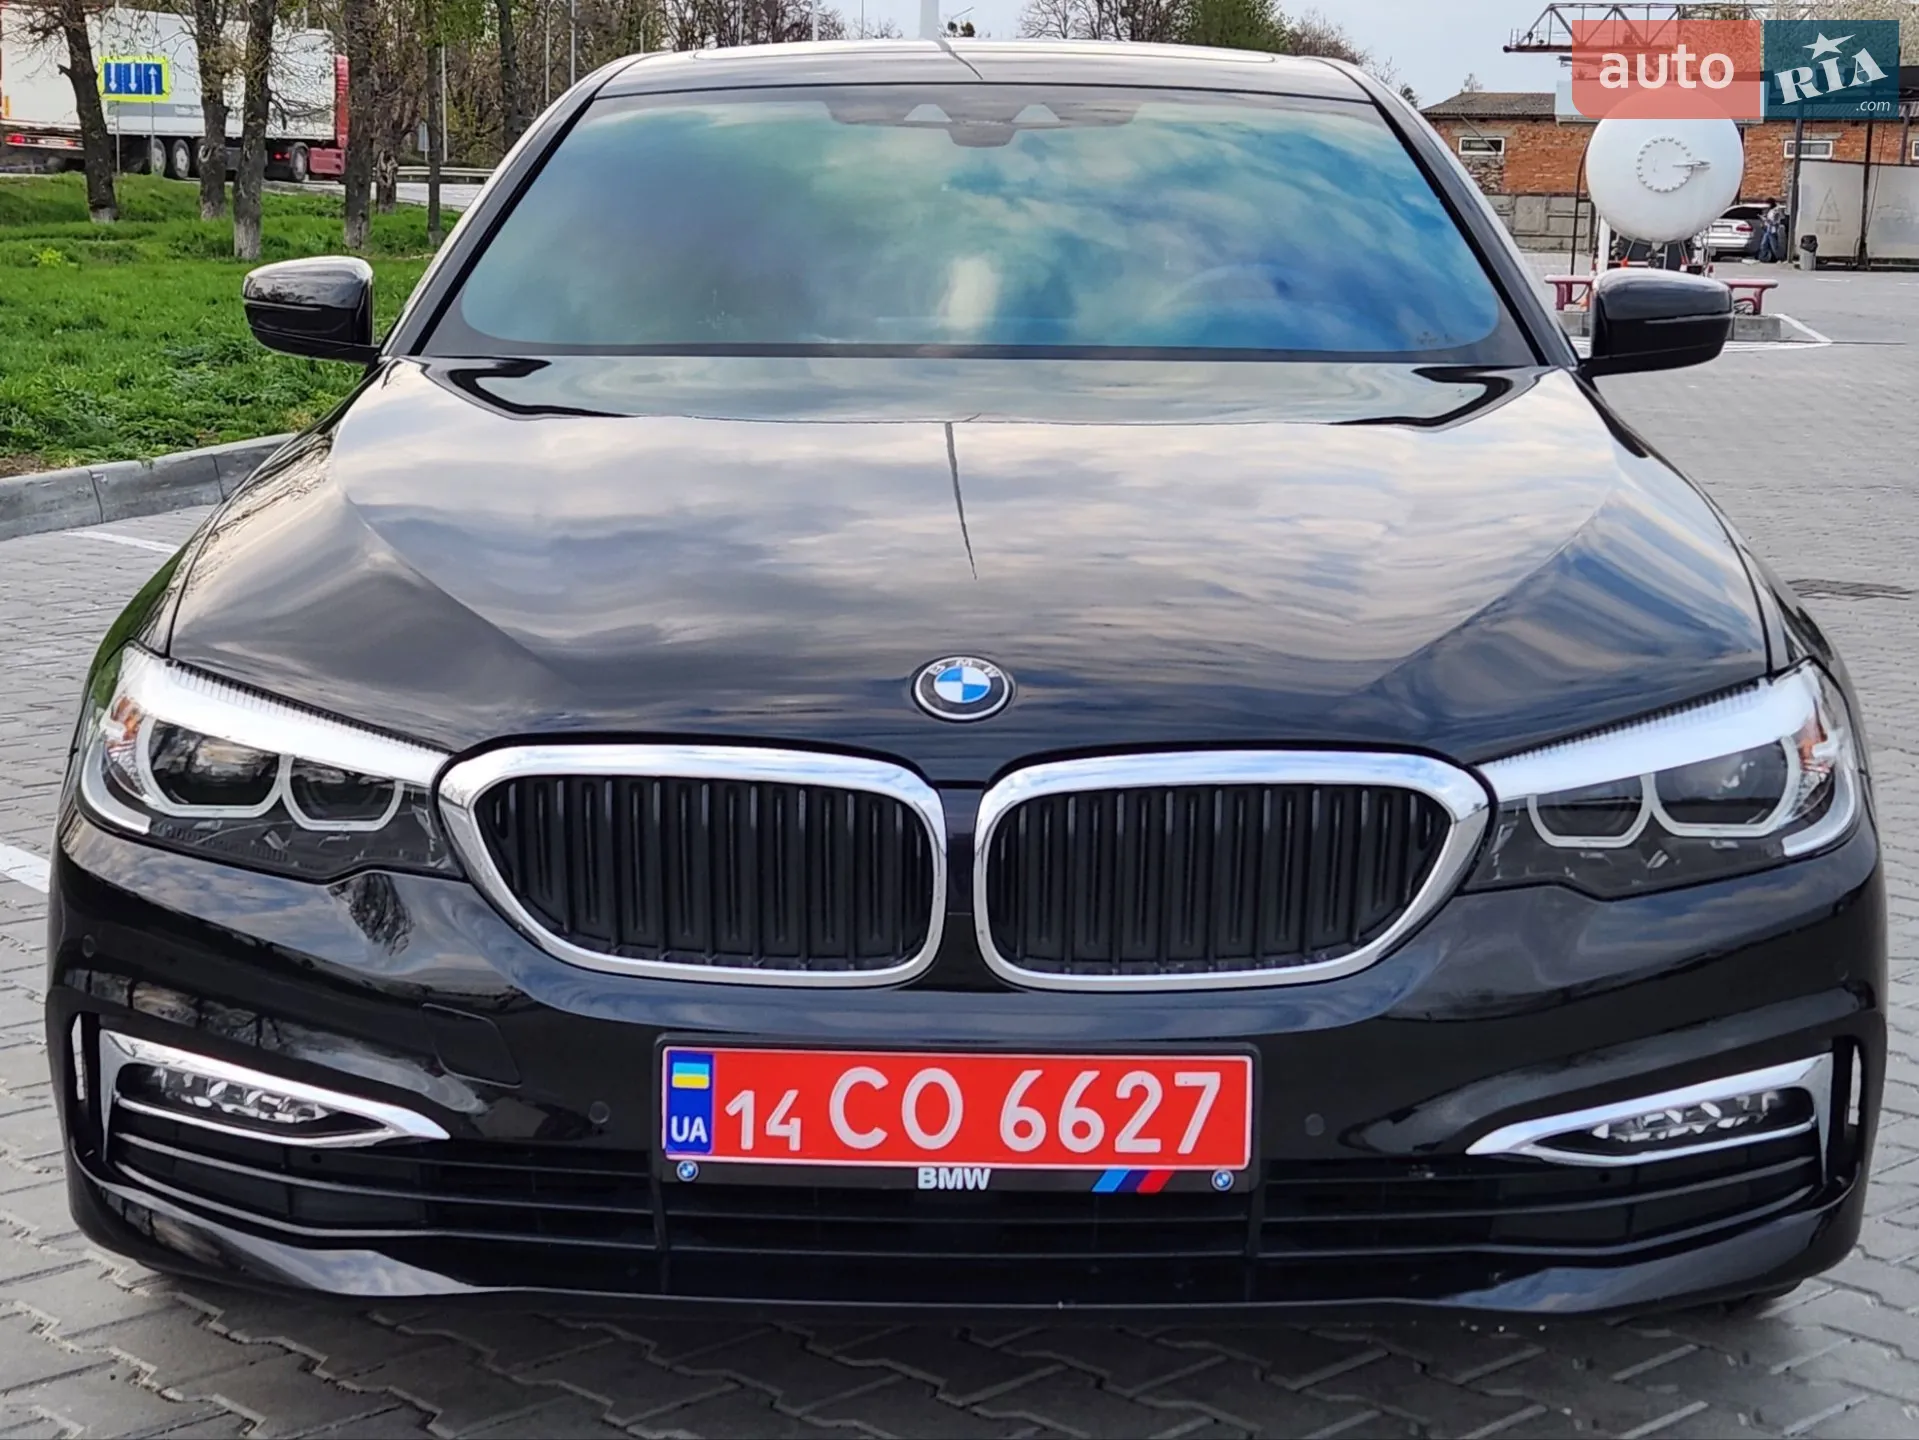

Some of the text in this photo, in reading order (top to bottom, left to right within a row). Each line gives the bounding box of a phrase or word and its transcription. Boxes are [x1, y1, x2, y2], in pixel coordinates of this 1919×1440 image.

[927, 659, 1000, 678] BMW
[724, 1066, 1222, 1155] 14 CO 6627
[670, 1115, 709, 1144] UA
[916, 1166, 992, 1191] BMW
